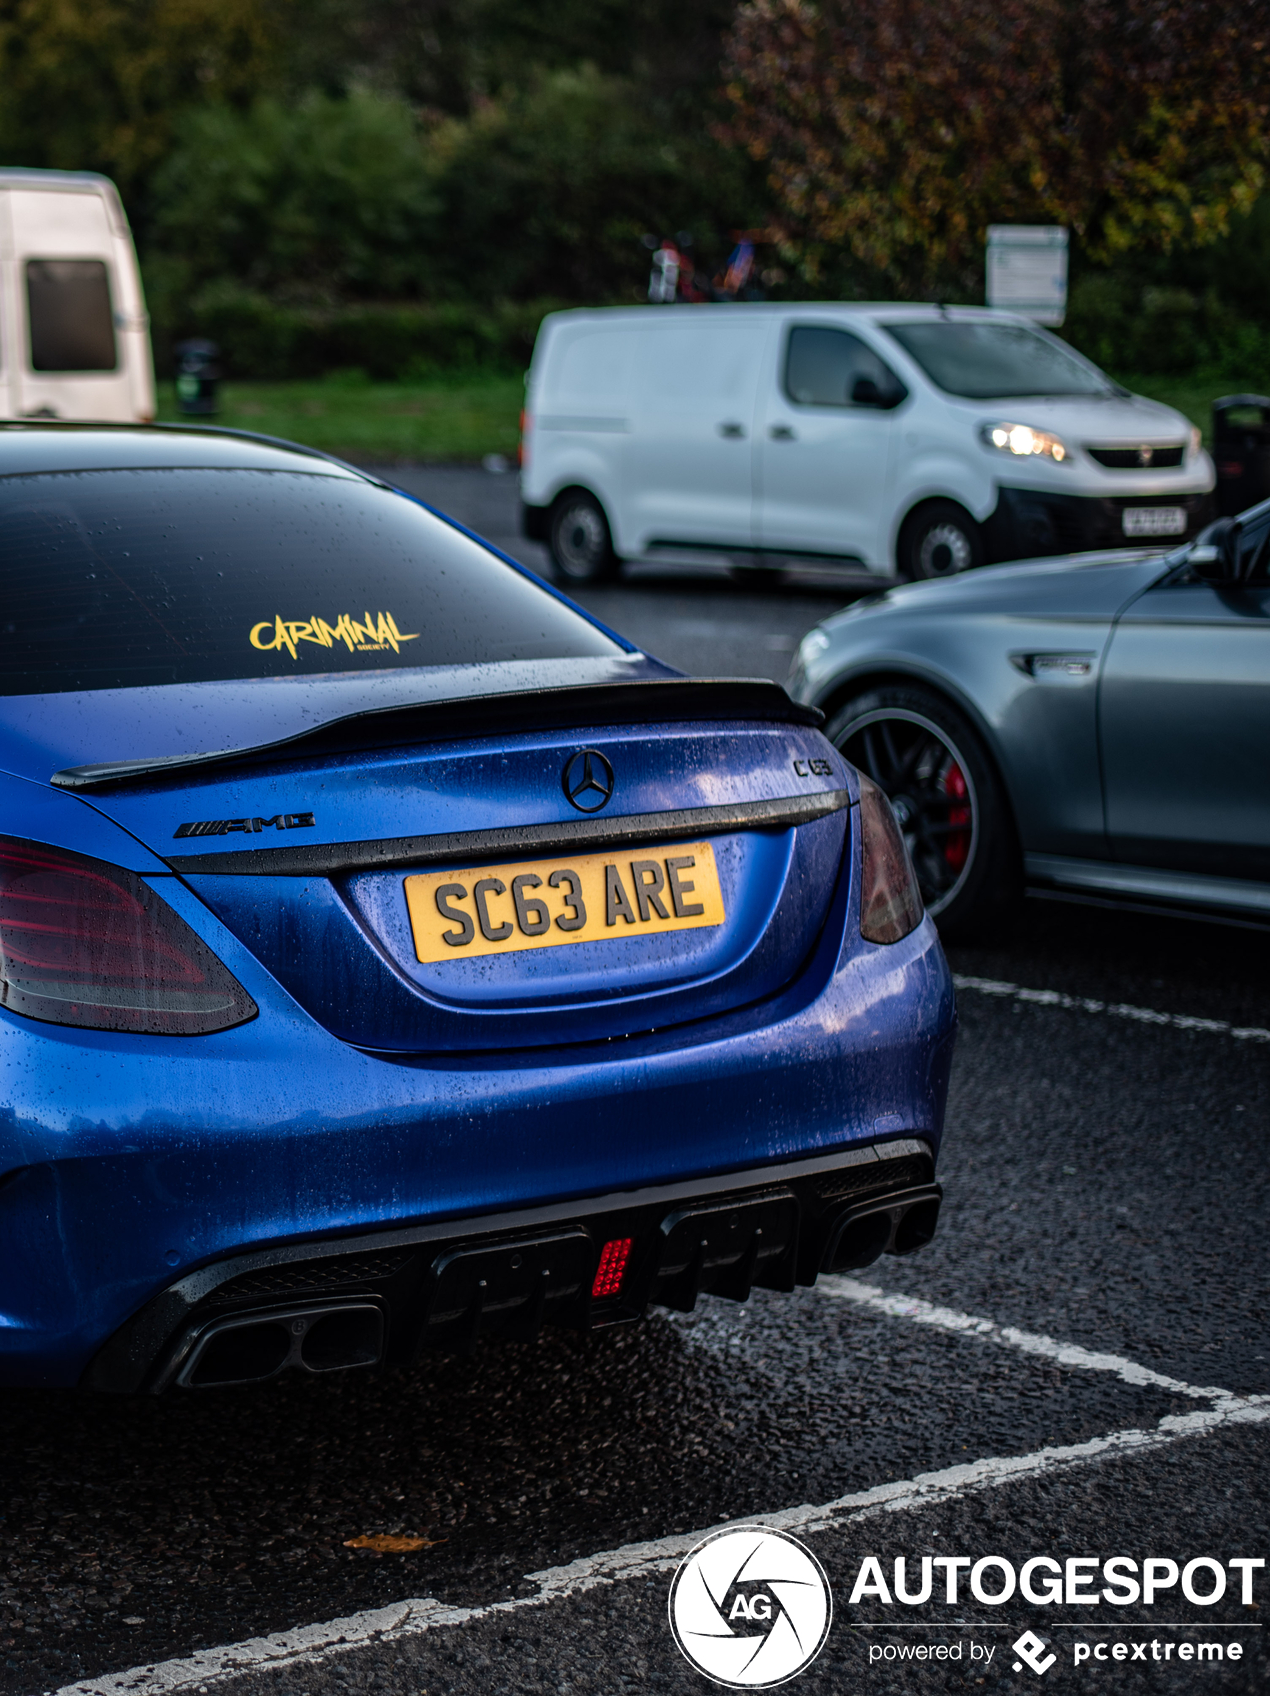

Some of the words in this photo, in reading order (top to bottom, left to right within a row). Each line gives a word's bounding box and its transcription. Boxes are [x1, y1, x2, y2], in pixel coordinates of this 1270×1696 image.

[356, 643, 390, 651] SOCIETY
[218, 812, 316, 836] AMG
[434, 869, 588, 947] SC63
[604, 855, 705, 927] ARE
